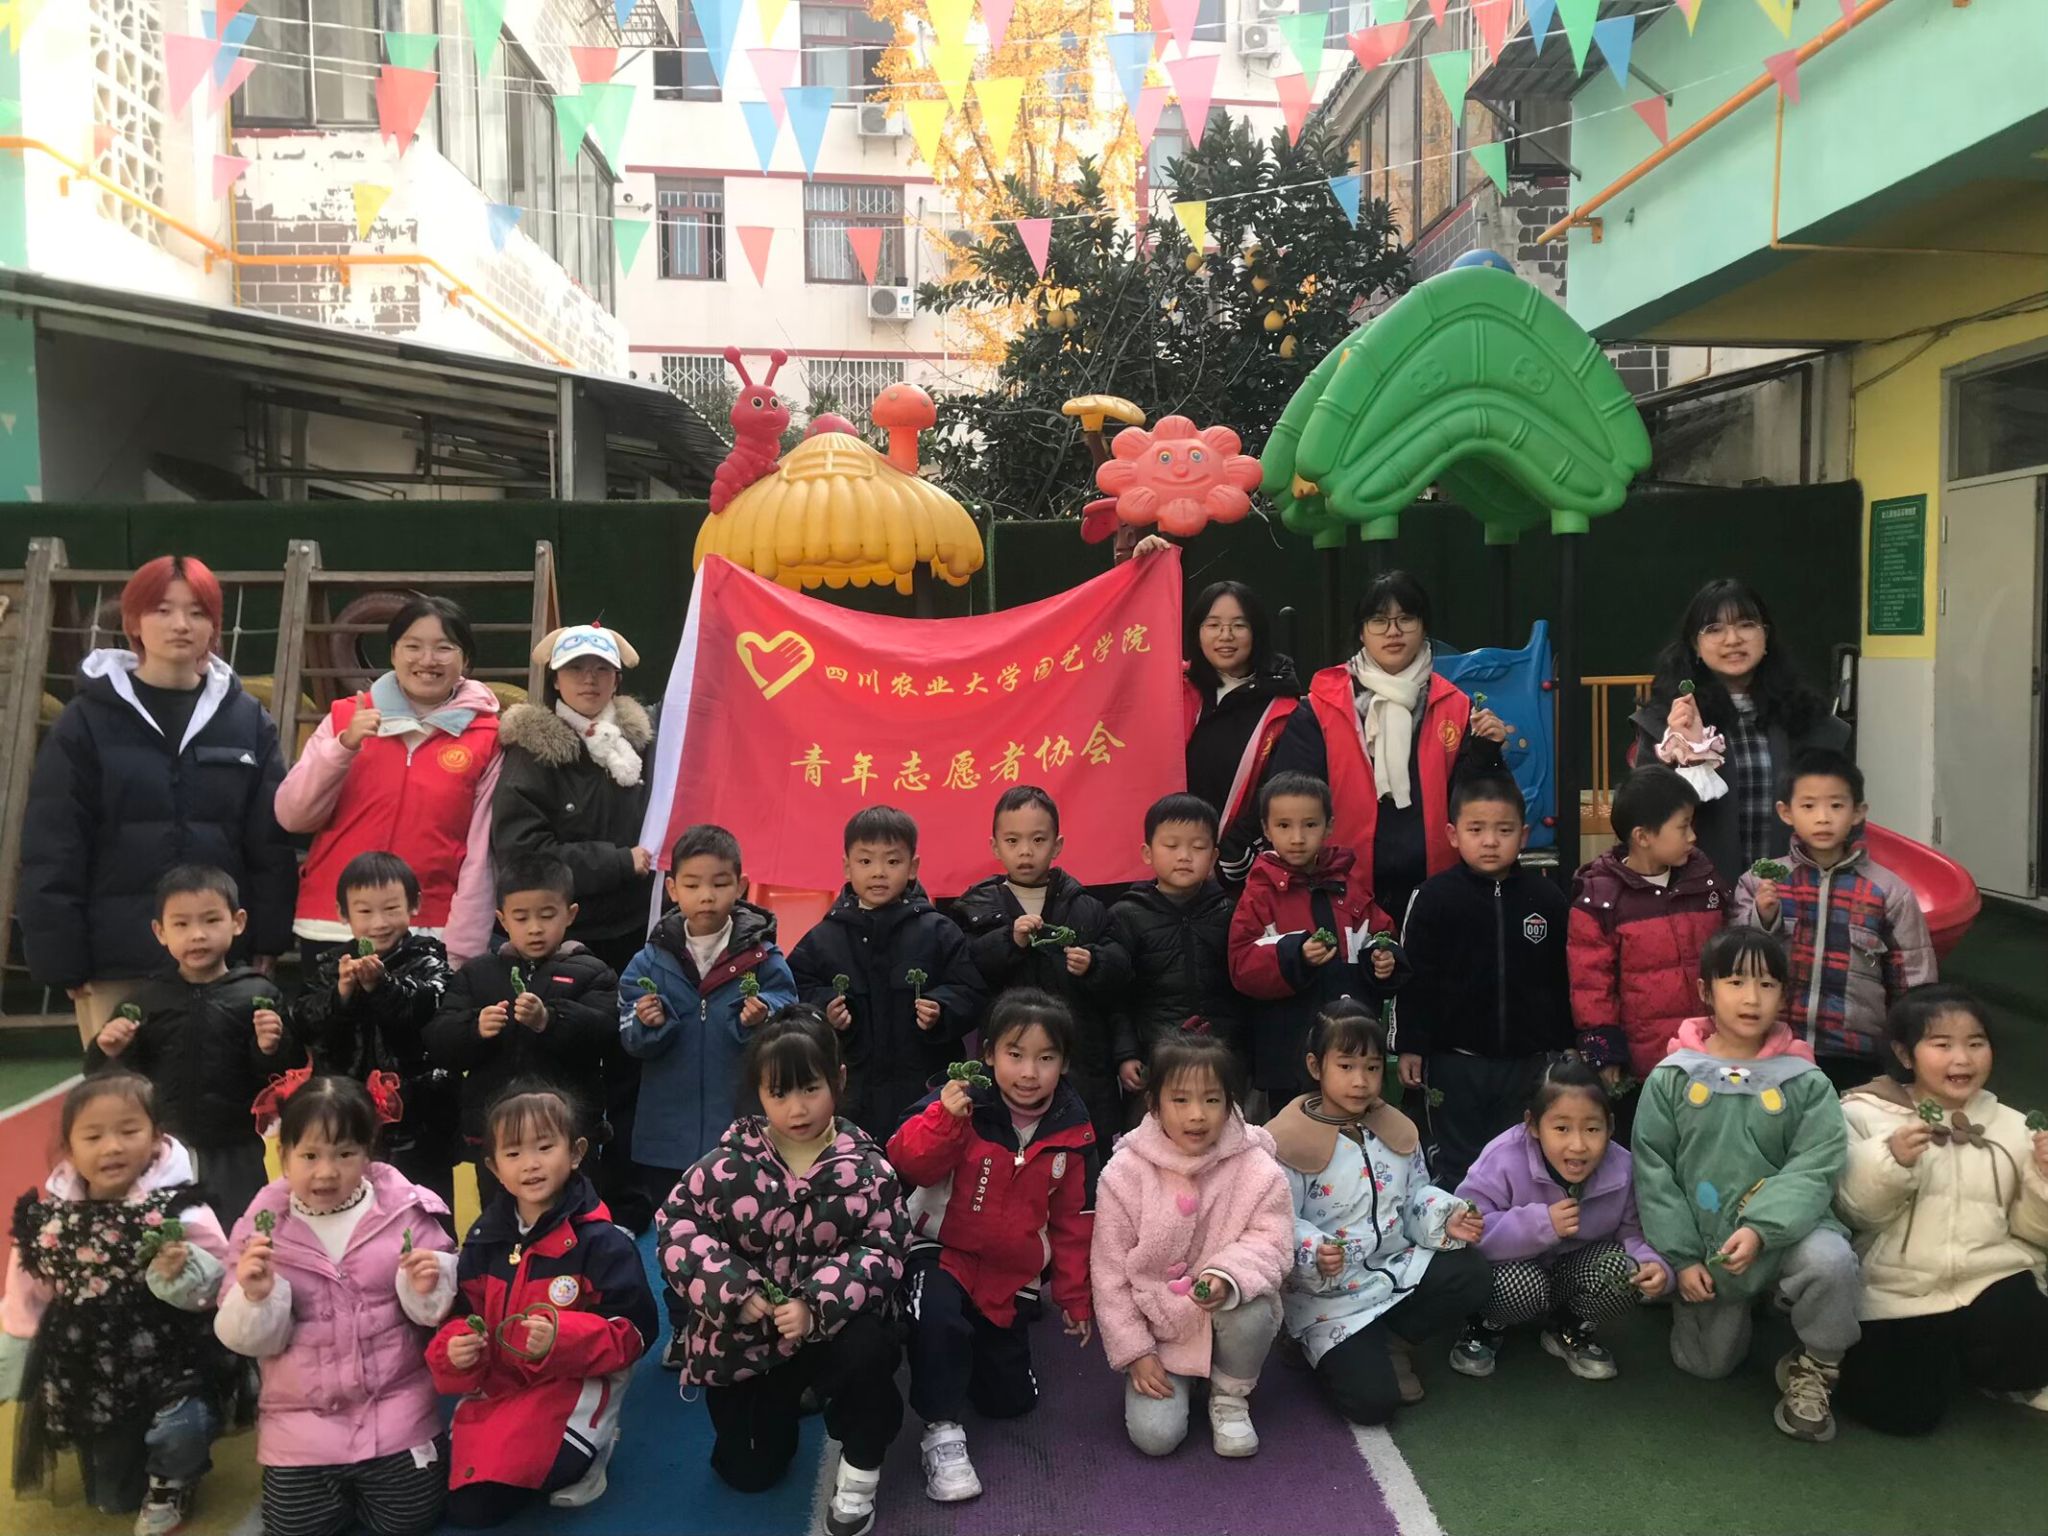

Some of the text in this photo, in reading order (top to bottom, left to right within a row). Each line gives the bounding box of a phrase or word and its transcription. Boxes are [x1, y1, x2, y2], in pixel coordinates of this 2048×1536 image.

[825, 624, 1151, 697] 四川农业大学园艺学院
[790, 720, 1126, 797] 青年志愿者协会
[1527, 925, 1545, 935] 007
[973, 1158, 992, 1212] SPORTS
